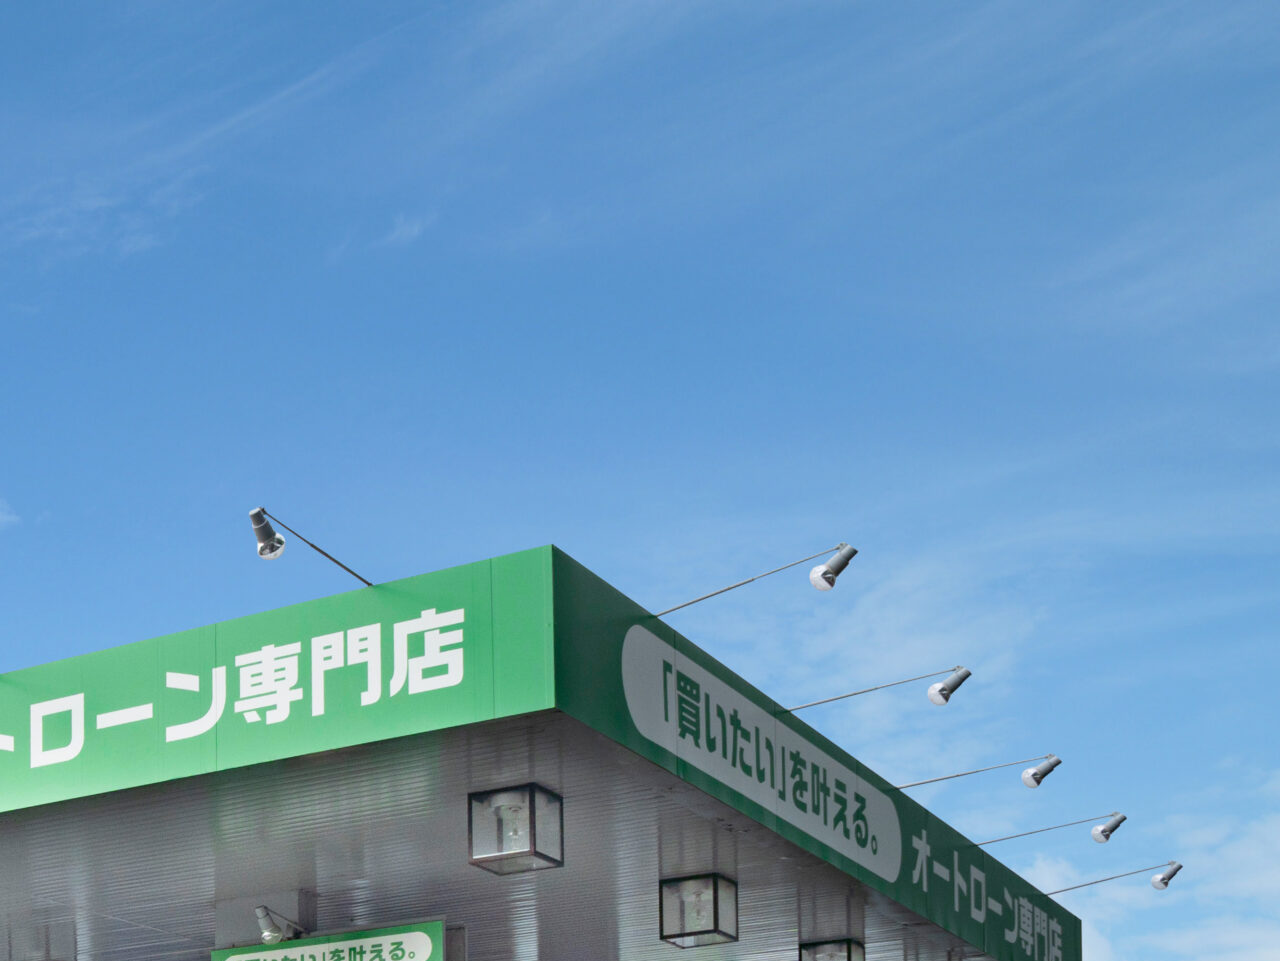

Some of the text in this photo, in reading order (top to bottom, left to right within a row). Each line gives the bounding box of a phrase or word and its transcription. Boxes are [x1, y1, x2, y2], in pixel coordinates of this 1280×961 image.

[662, 658, 878, 856] 「買いたい」を叶える。
